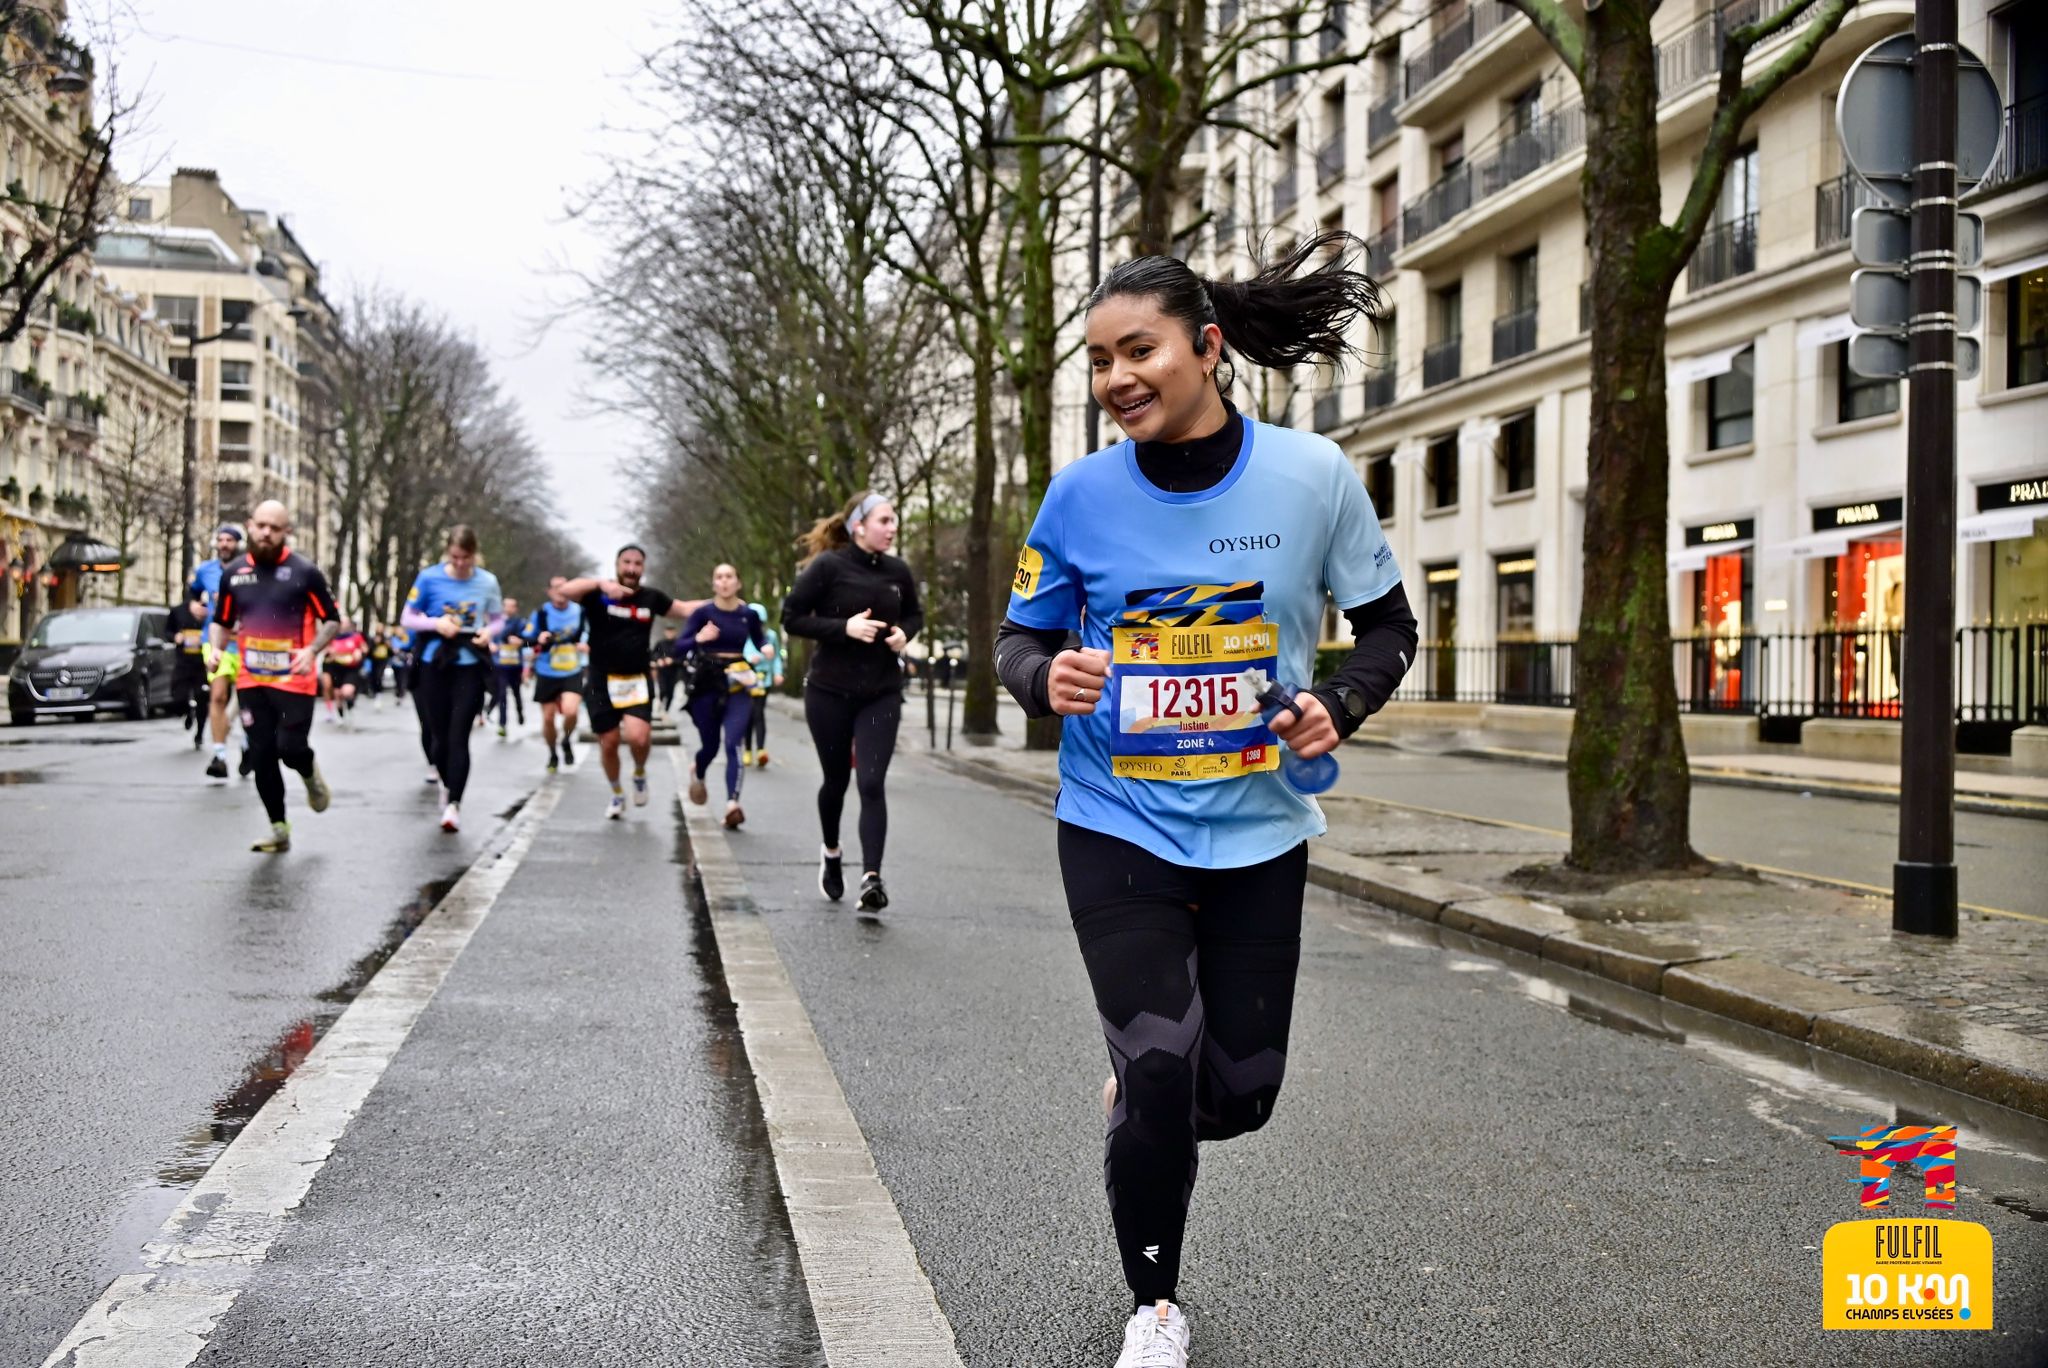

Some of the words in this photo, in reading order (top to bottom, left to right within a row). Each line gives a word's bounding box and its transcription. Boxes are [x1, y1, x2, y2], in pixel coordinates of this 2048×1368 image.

[1209, 533, 1281, 554] OYSHO
[1172, 633, 1213, 655] FULFIL
[1223, 636, 1240, 649] 10
[1148, 676, 1239, 718] 12315
[1179, 721, 1209, 731] Justine
[1177, 739, 1205, 749] ZONE
[1208, 738, 1215, 747] 4
[1119, 761, 1163, 773] OYSHO
